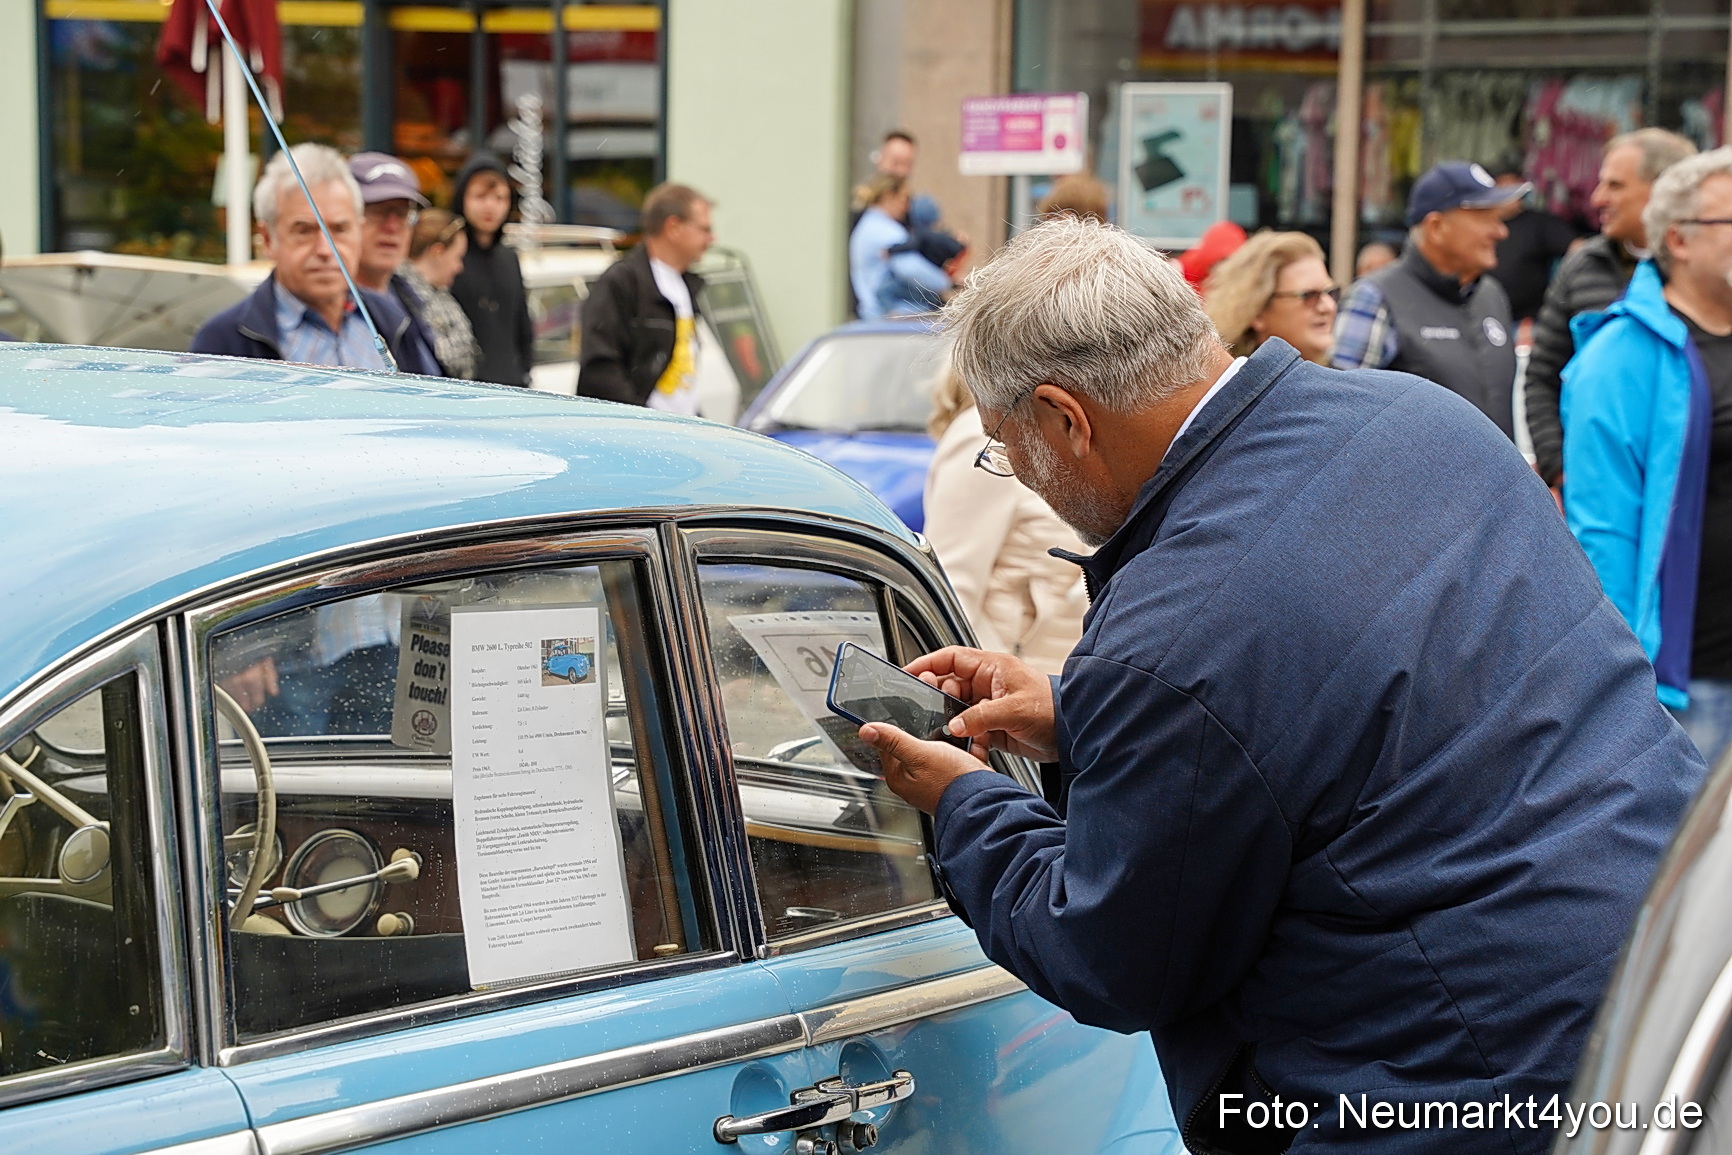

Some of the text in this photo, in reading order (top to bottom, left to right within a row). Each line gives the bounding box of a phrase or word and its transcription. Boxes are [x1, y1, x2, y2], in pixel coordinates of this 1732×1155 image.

[411, 633, 450, 657] Please
[414, 659, 446, 681] don't
[408, 681, 448, 705] touch!
